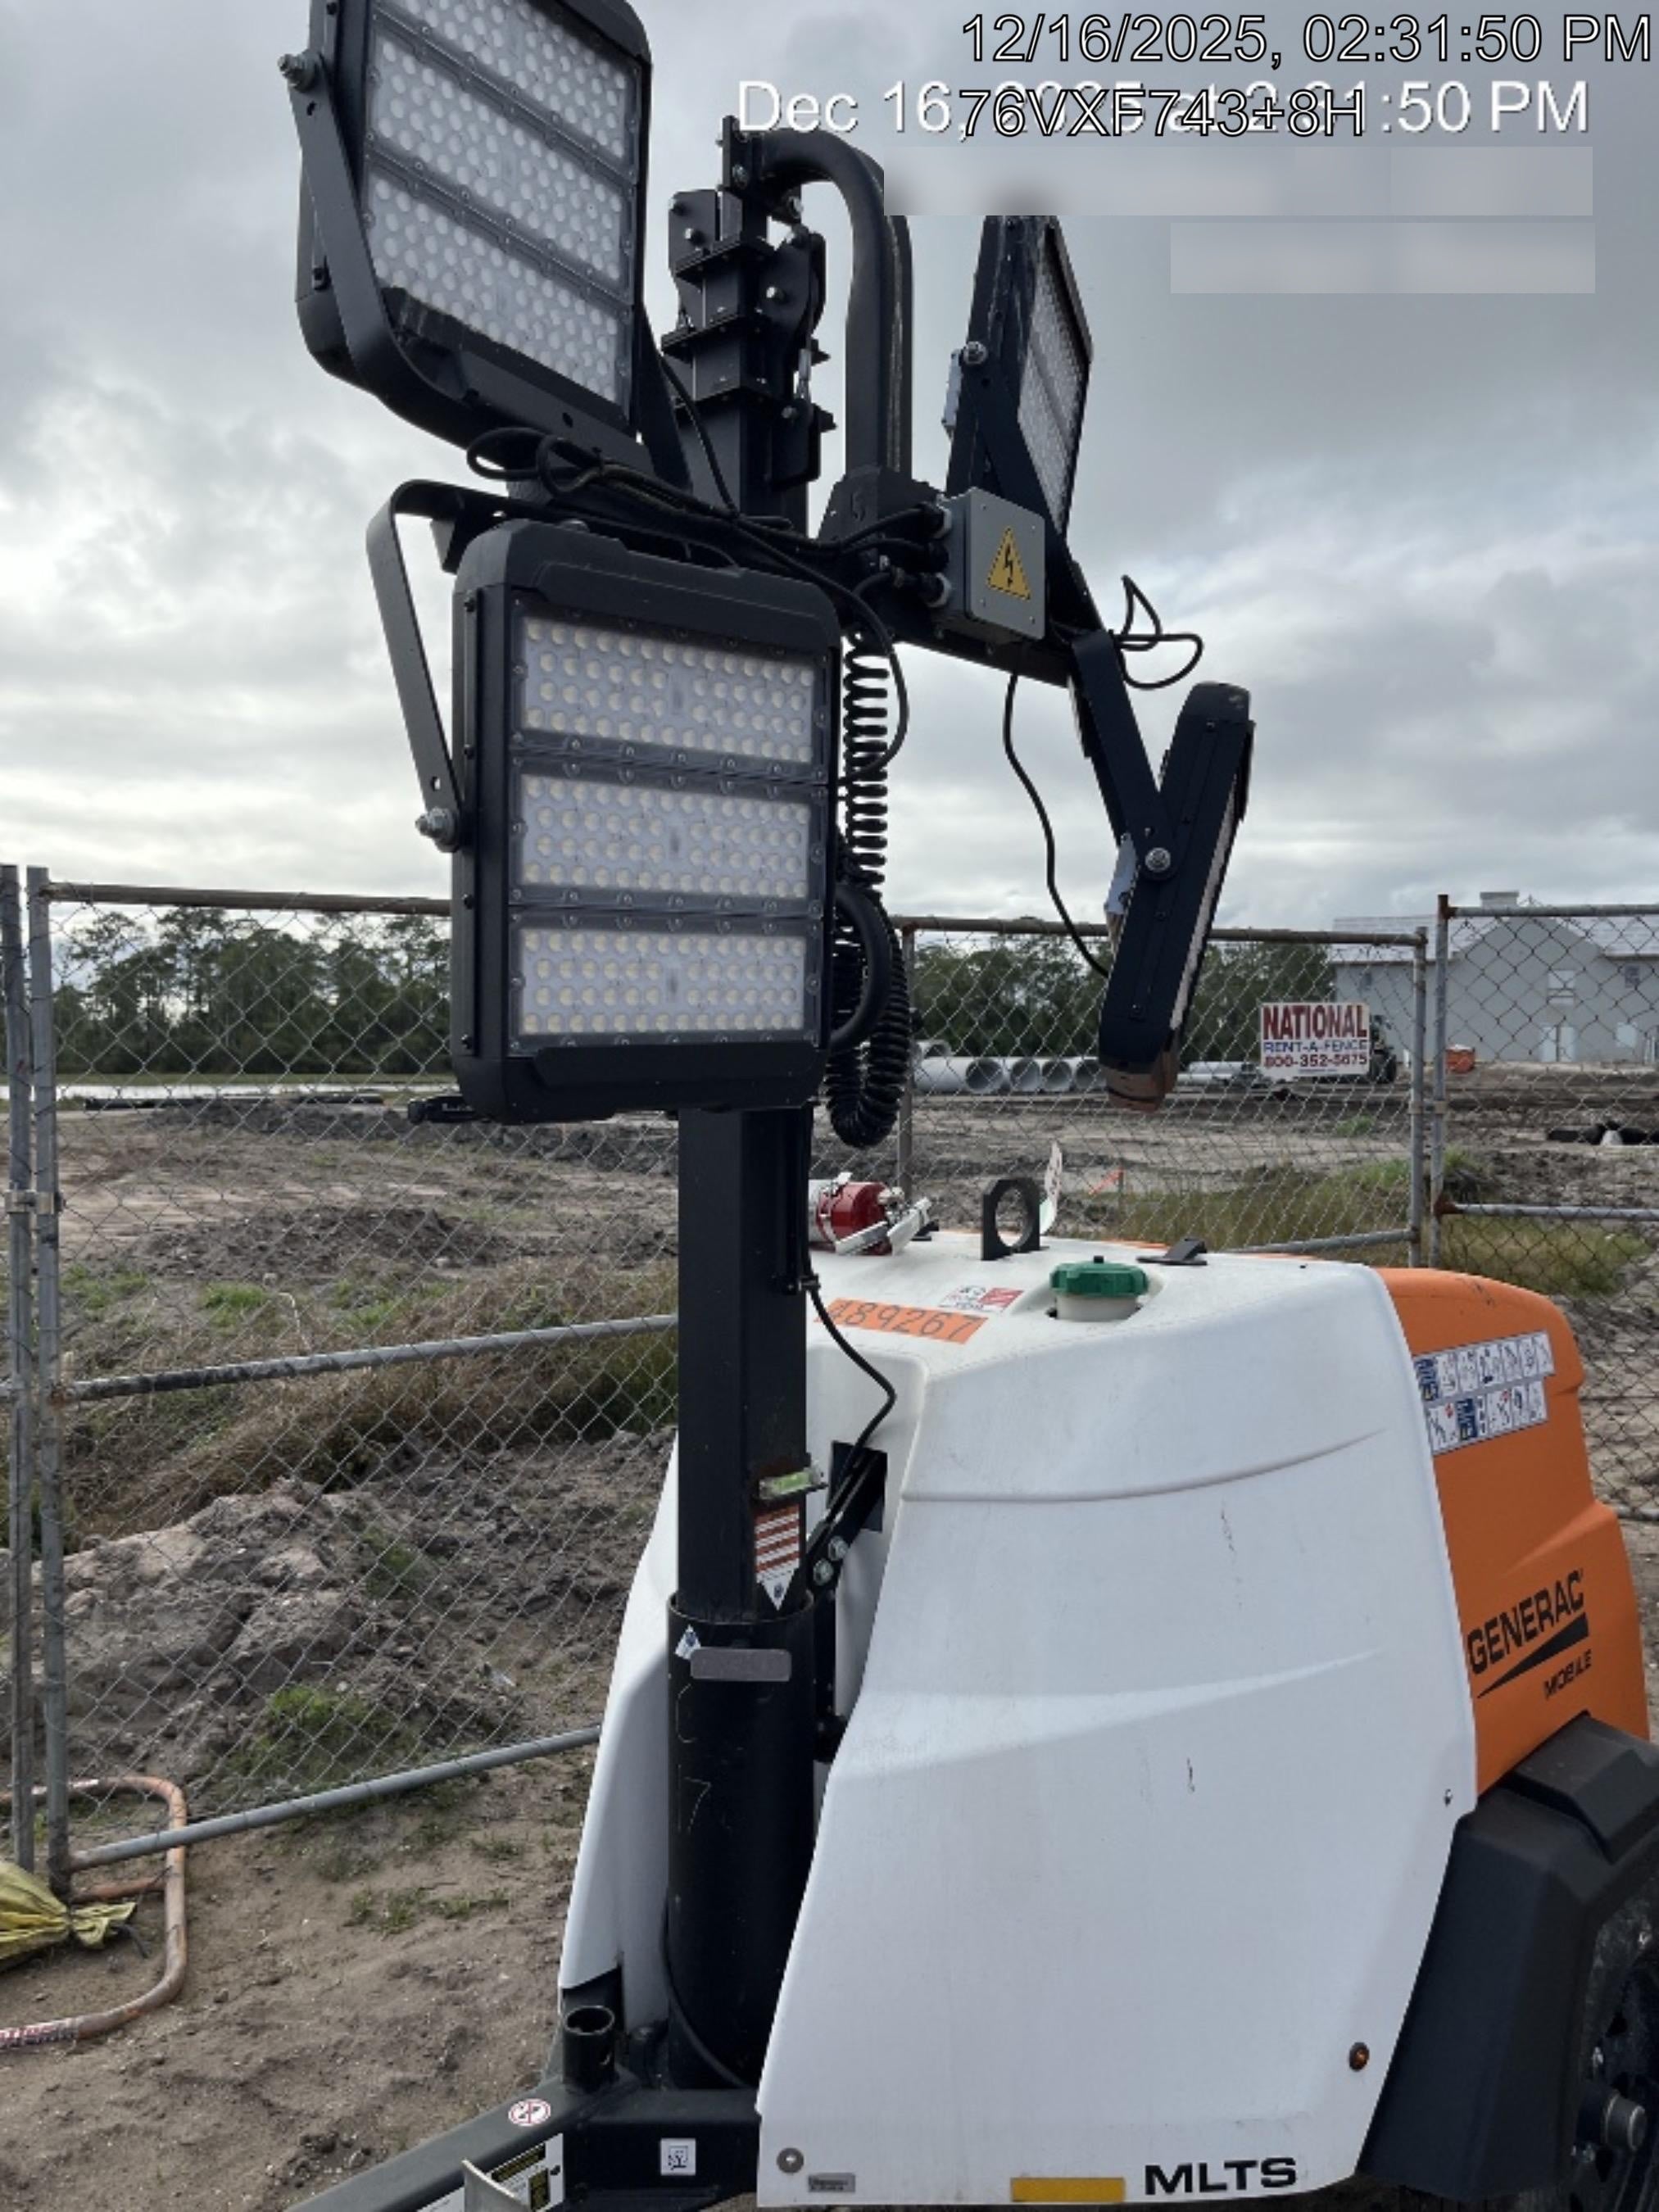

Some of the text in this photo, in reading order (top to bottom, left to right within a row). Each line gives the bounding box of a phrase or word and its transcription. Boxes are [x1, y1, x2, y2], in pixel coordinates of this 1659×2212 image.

[1262, 1004, 1367, 1040] NATIONAL
[1467, 1569, 1584, 1675] GENERAC
[1543, 1648, 1592, 1701] MOBILE
[1145, 2157, 1296, 2195] MLTS
